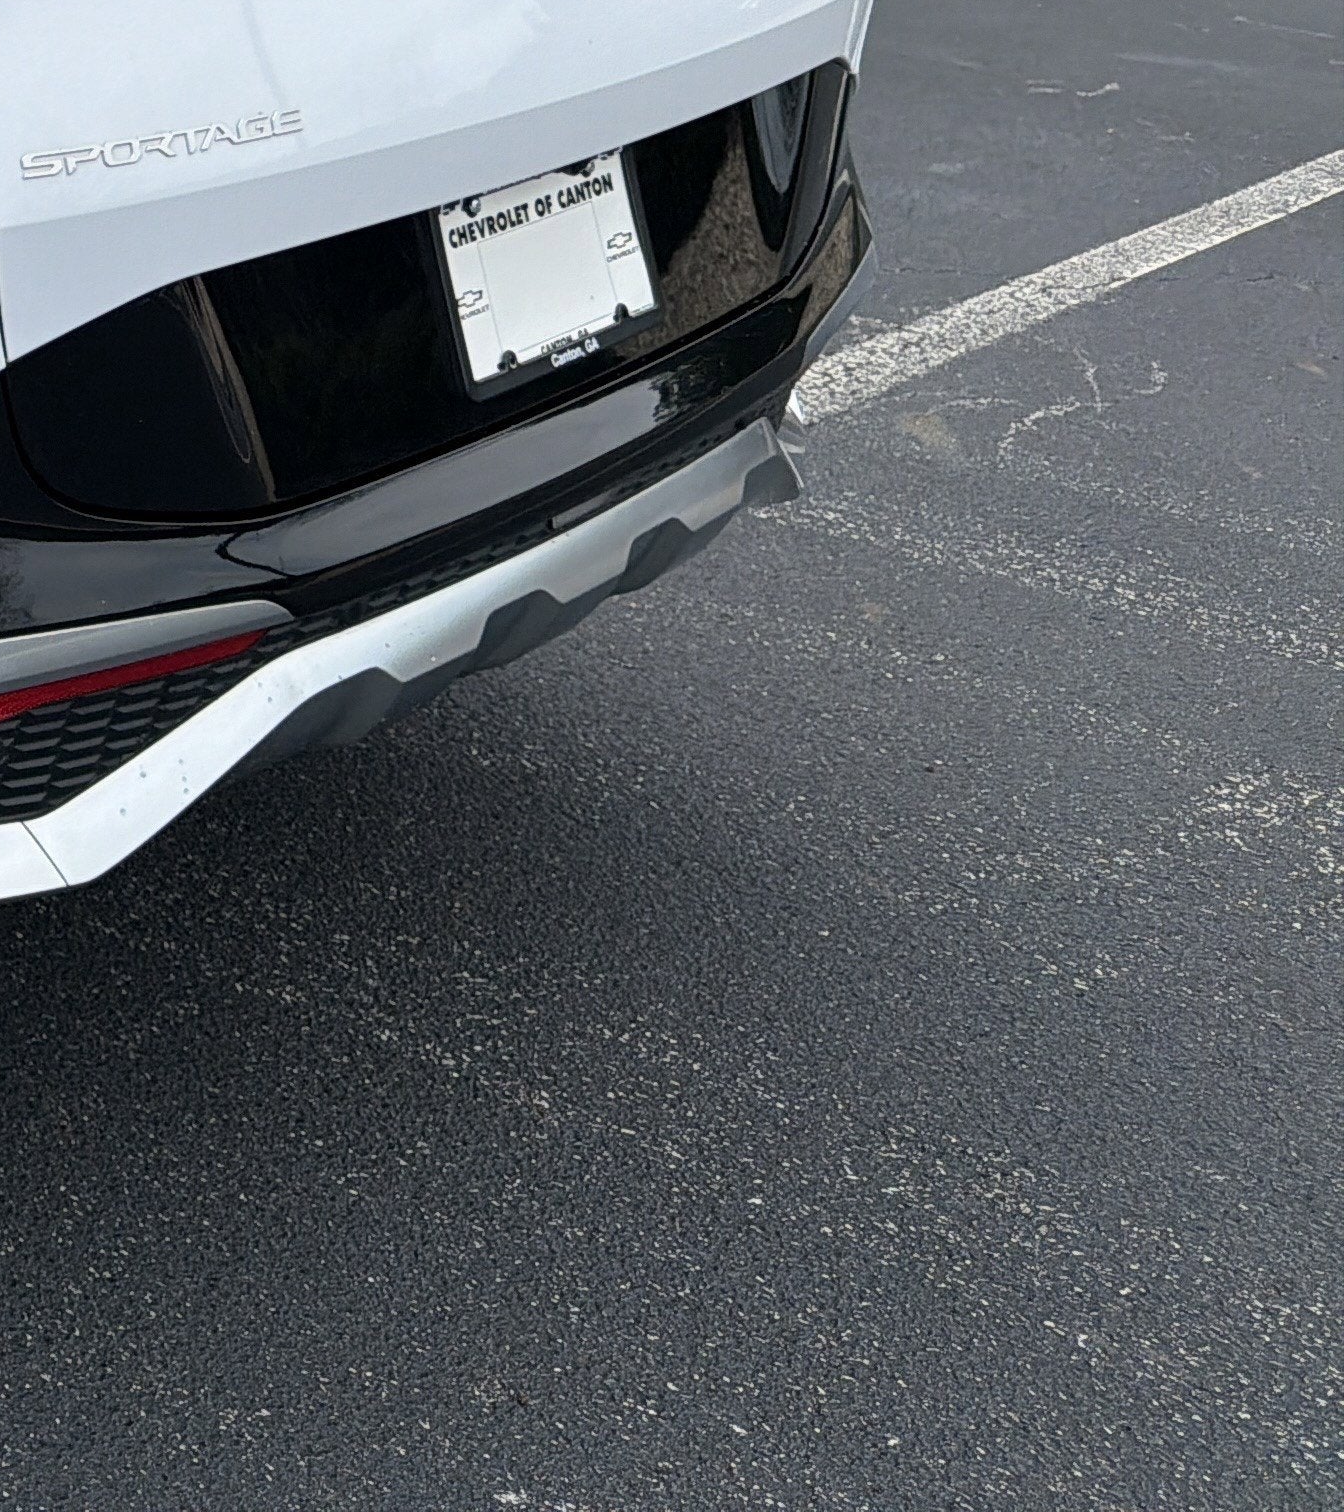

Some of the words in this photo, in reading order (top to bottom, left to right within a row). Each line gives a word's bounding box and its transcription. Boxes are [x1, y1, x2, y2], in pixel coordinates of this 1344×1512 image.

[20, 108, 303, 180] SPORTAGE
[448, 202, 530, 249] CHEVROLET
[534, 194, 553, 218] OF
[557, 172, 614, 209] CANTON
[460, 303, 490, 320] HEVROLET
[584, 336, 600, 354] GA
